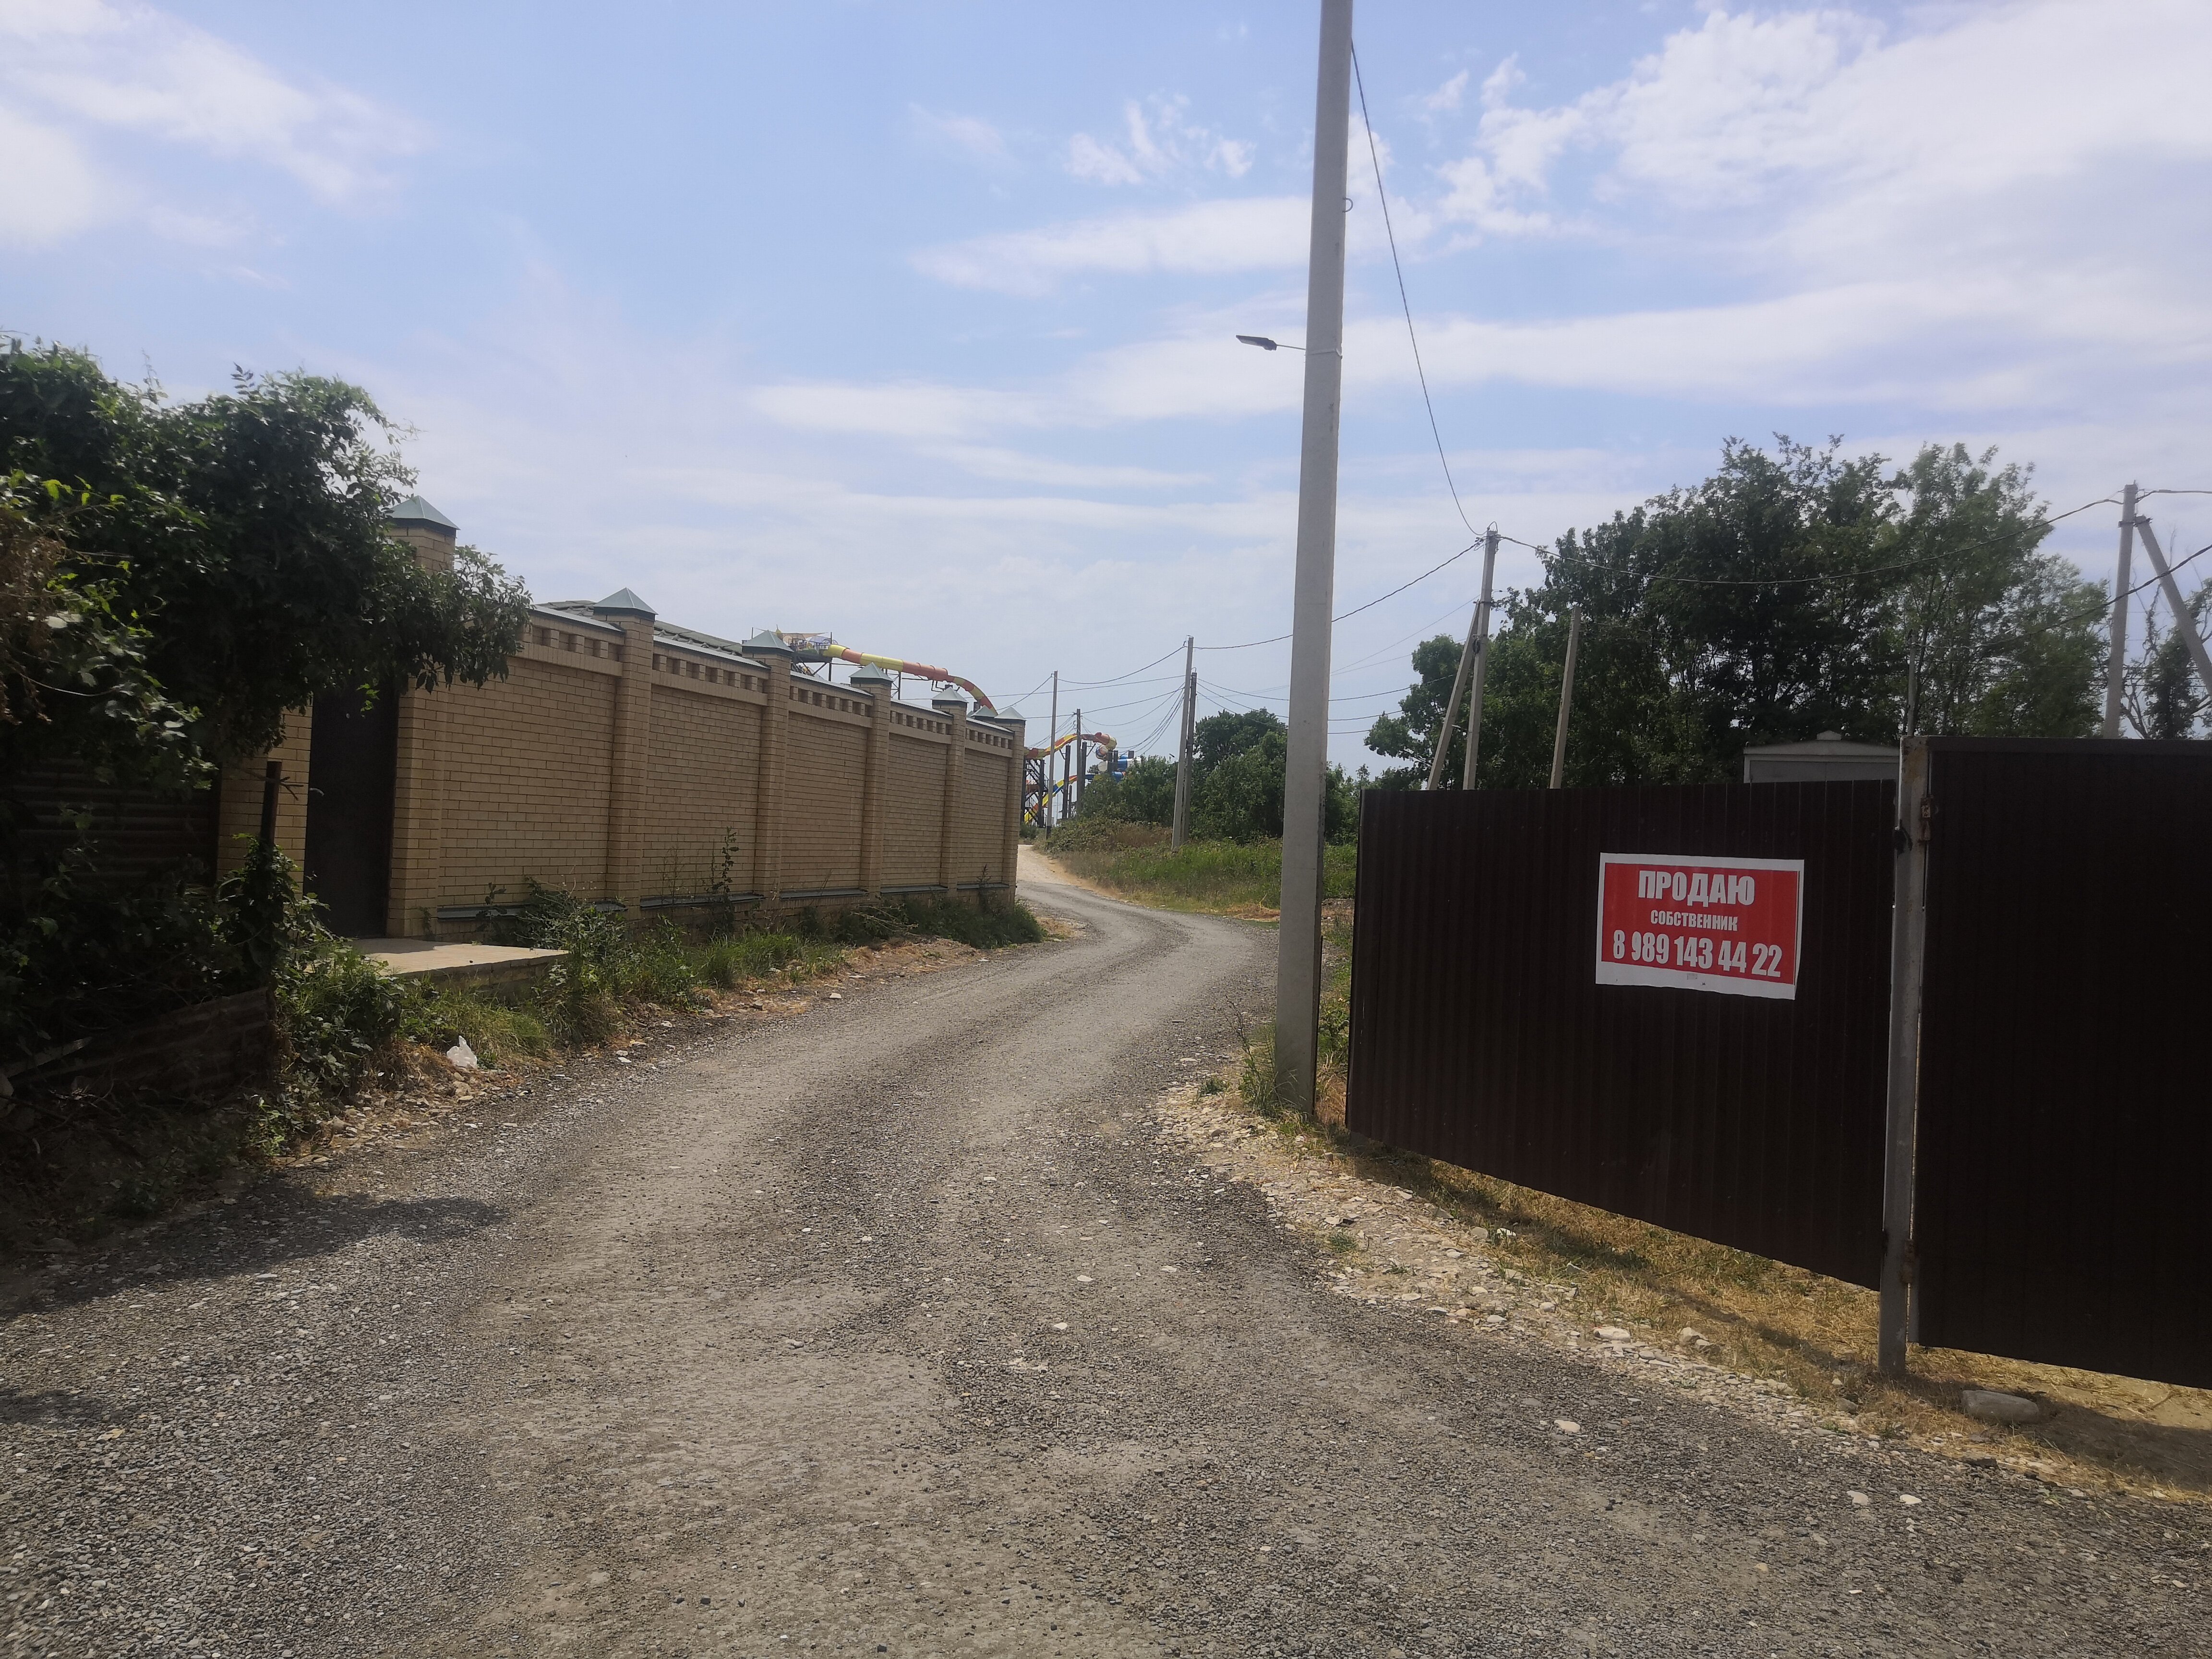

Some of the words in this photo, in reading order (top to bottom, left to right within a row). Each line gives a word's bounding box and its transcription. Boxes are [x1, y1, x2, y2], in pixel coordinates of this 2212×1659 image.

[1638, 870, 1755, 907] ПРОДАЮ
[1651, 910, 1738, 931] СОБСТВЕННИК
[1613, 930, 1625, 959] 8
[1631, 931, 1670, 964] 989
[1674, 936, 1713, 969] 143
[1718, 940, 1746, 973] 44
[1752, 943, 1782, 977] 22
